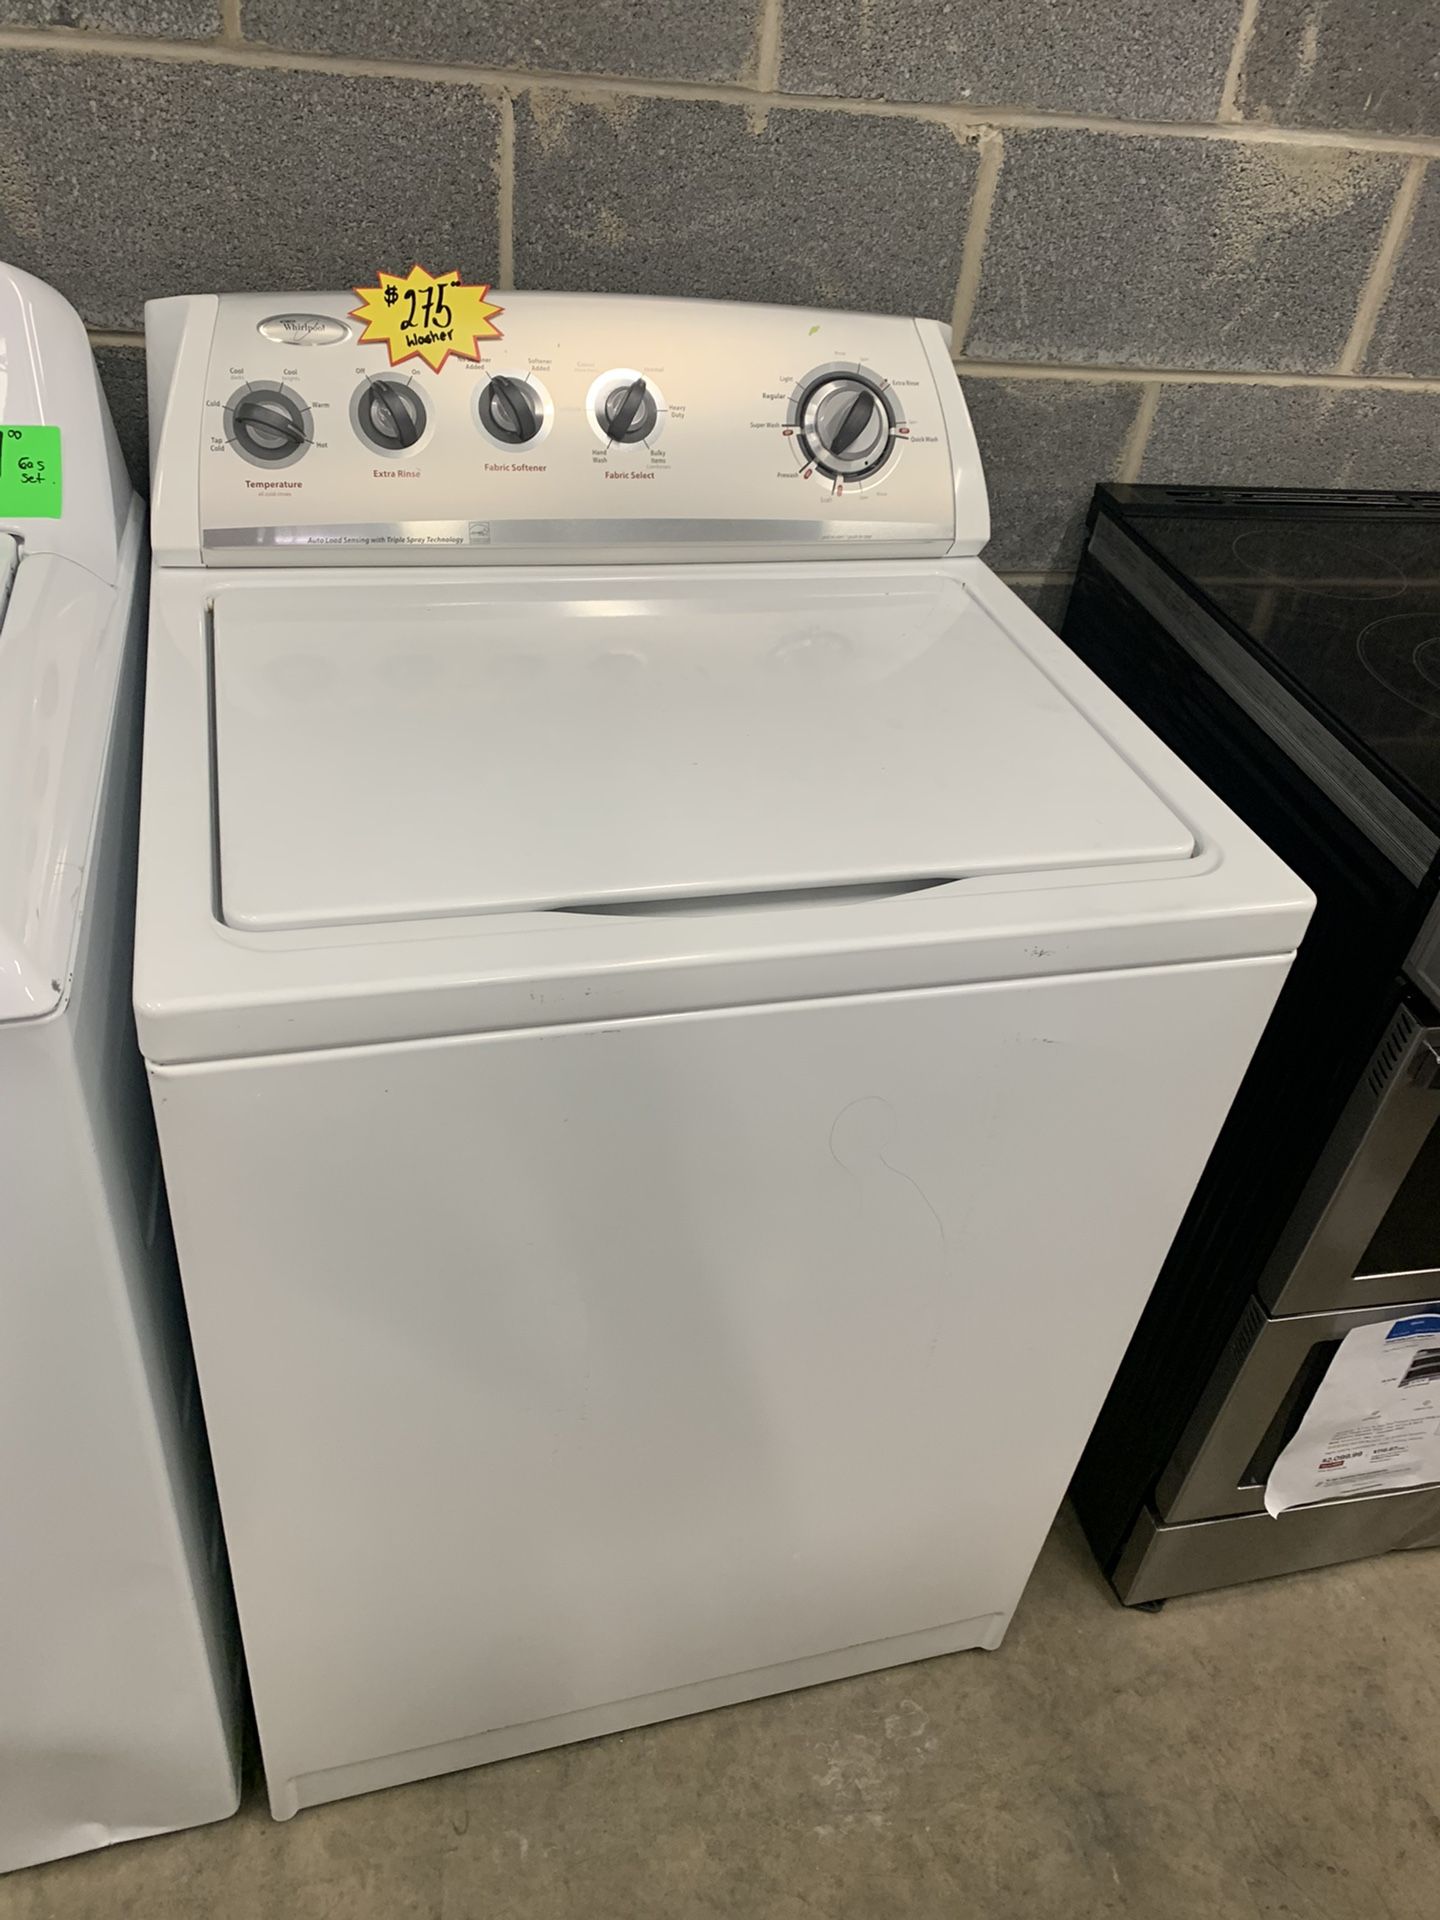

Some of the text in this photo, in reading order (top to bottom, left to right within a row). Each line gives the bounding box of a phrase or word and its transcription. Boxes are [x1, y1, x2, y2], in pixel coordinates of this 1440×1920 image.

[283, 321, 326, 334] Whirlpool
[406, 329, 453, 347] Washer
[229, 367, 244, 375] Cool
[283, 368, 298, 376] Cool
[355, 367, 366, 375] Off
[411, 368, 421, 376] On
[762, 392, 787, 400] Regular
[206, 400, 221, 408] Cold
[669, 405, 686, 413] Heavy
[671, 412, 685, 420] Duty
[750, 422, 765, 430] Super
[650, 449, 666, 458] Bulky
[484, 463, 547, 472] Fabric Softener
[373, 469, 421, 478] Extra Rinse
[605, 471, 655, 480] Fabric Select
[777, 470, 799, 478] Prewash
[245, 480, 303, 490] Temperature
[307, 536, 325, 544] Auto
[325, 536, 342, 544] Load
[343, 536, 370, 545] Sensing
[387, 535, 406, 544] Triple
[406, 535, 425, 545] Spray
[427, 535, 464, 545] Technology
